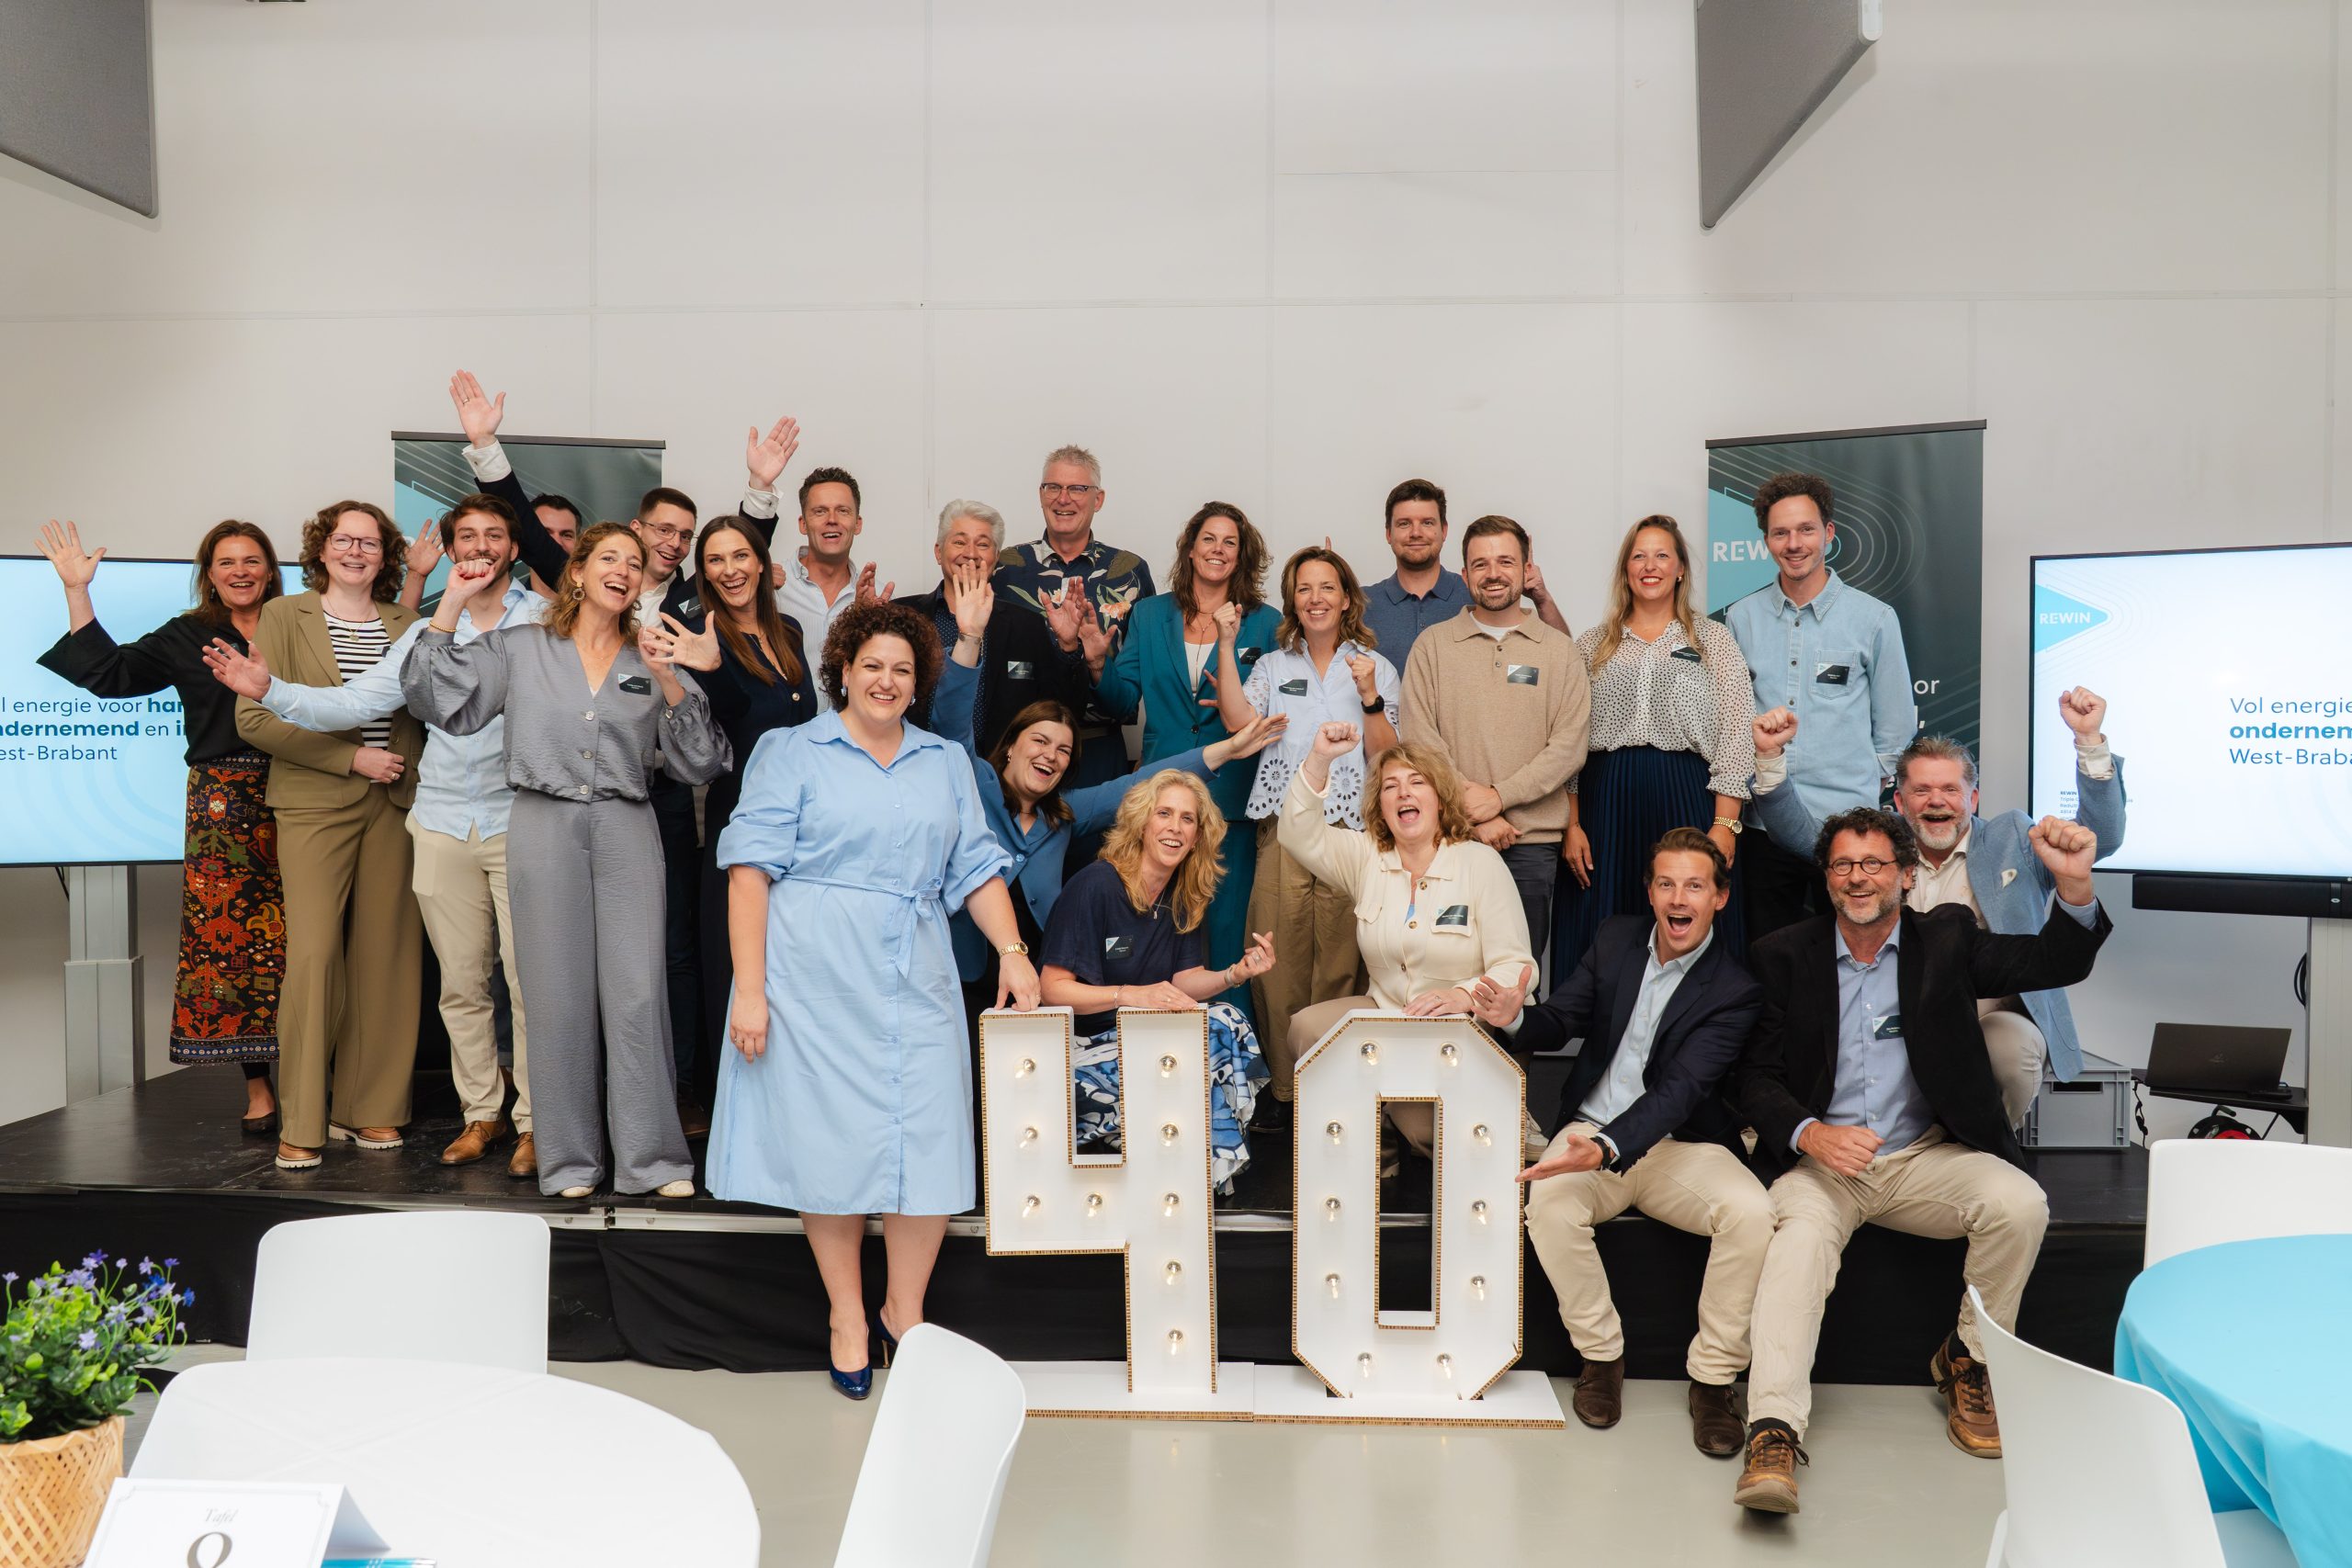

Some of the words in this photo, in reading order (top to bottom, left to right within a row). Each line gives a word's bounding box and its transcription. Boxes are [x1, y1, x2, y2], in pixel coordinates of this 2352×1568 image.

[1713, 539, 1770, 562] REW
[2040, 612, 2091, 625] REWIN
[1914, 680, 1940, 694] or
[13, 698, 91, 716] energie
[97, 701, 142, 713] voor
[148, 697, 183, 713] ha
[2230, 696, 2263, 714] Vol
[145, 725, 169, 737] en
[2229, 748, 2352, 765] West-Brab
[979, 1007, 1526, 1401] 40
[205, 1506, 240, 1526] Tafel
